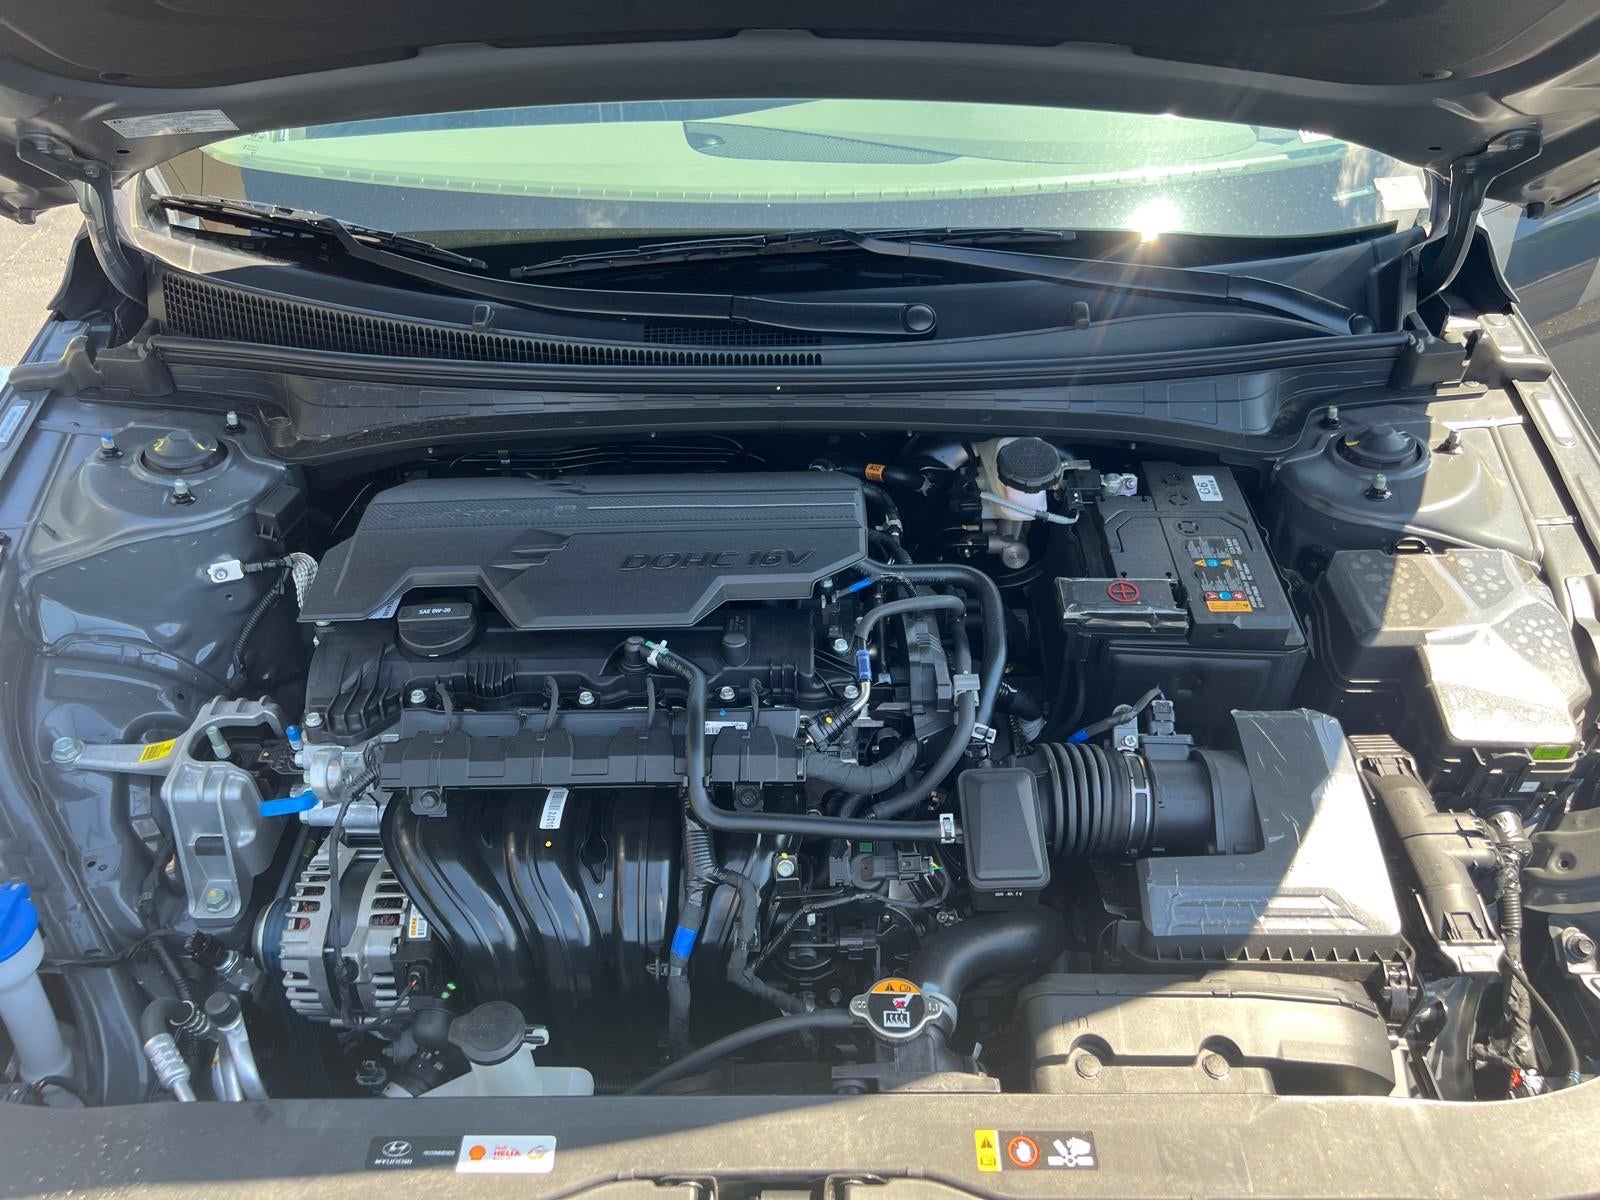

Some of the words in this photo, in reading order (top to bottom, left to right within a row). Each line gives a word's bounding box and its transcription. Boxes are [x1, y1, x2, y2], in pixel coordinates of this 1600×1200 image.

[1198, 481, 1211, 495] G6
[618, 551, 740, 571] DOHC
[748, 547, 817, 568] 16V
